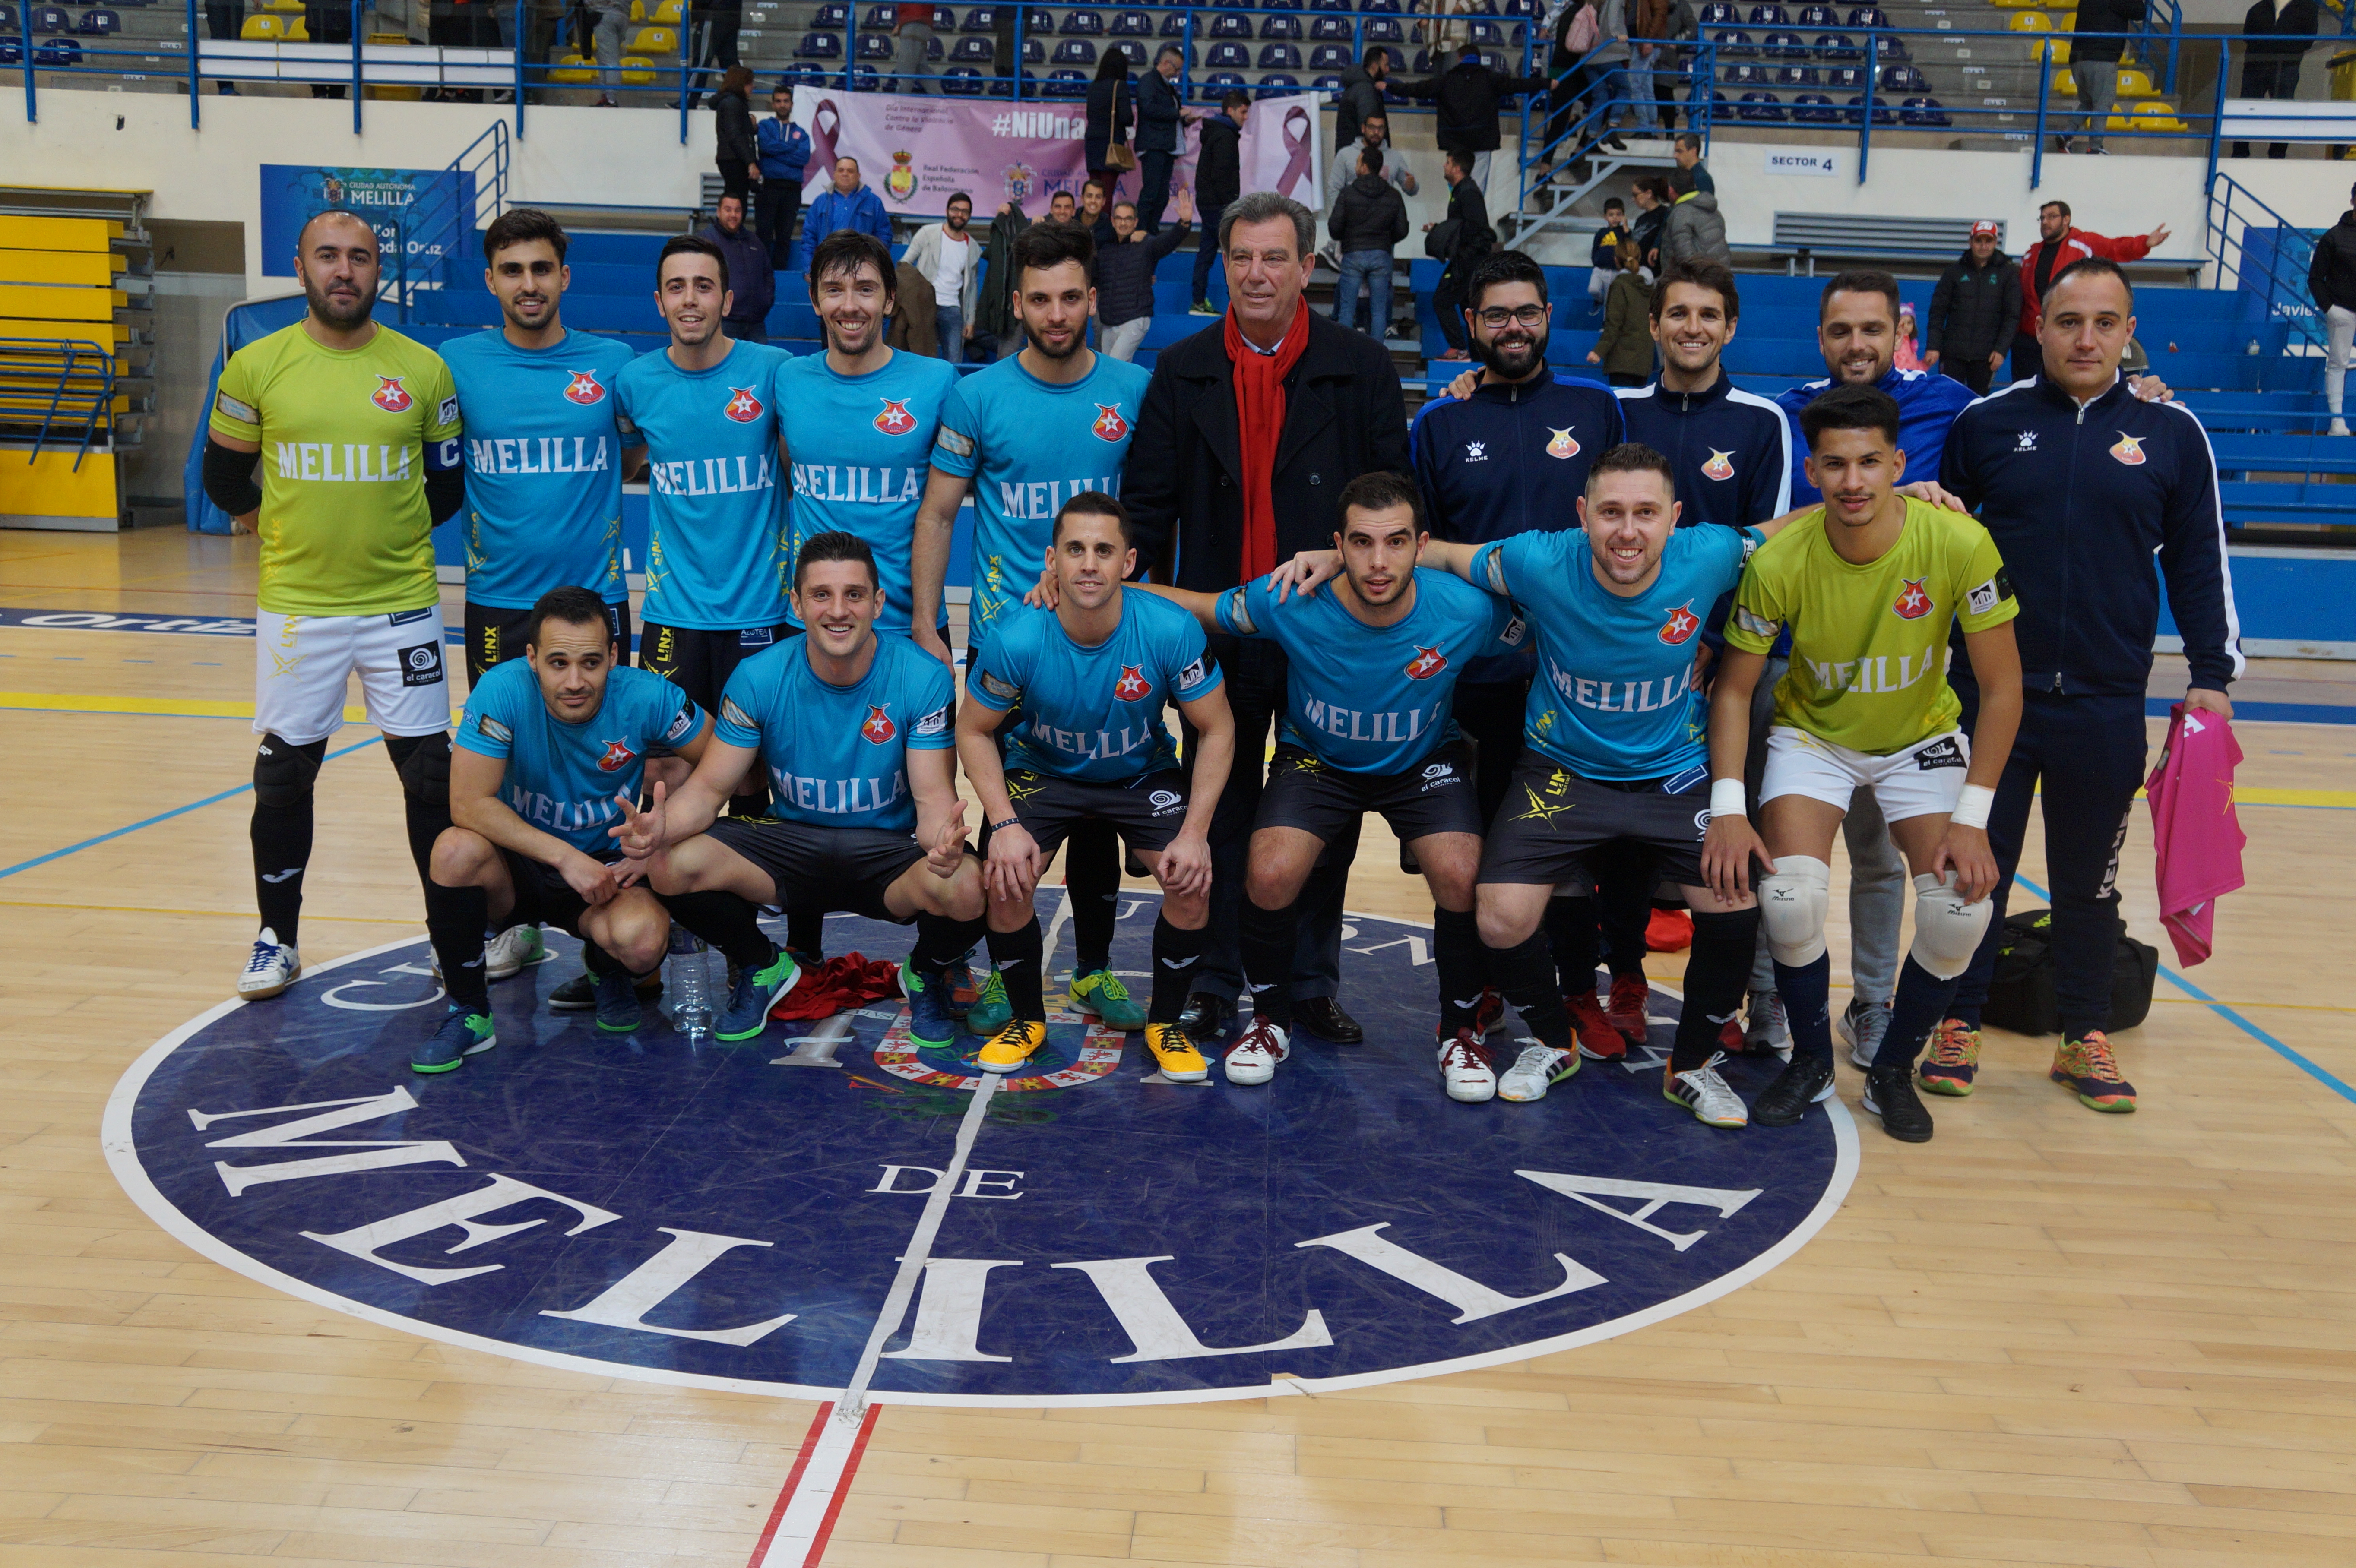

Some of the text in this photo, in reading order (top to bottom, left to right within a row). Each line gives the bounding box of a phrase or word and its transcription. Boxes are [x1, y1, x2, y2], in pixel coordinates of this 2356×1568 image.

[992, 111, 1087, 140] #NiUna
[1771, 156, 1834, 172] SECTOR 4
[351, 190, 415, 206] MELILLA
[276, 442, 410, 482] MELILLA
[440, 437, 460, 467] C
[471, 436, 608, 474] MELILLA
[652, 454, 774, 496] MELILLA
[793, 462, 920, 503] MELILLA
[484, 626, 497, 663] LINX
[656, 626, 672, 662] LINX
[415, 668, 441, 681] caracol
[1549, 656, 1691, 712] MELILLA
[770, 765, 907, 814] MELILLA
[1431, 776, 1461, 787] caracol
[866, 1163, 1024, 1200] DE
[187, 1084, 1763, 1364] MELILLA
